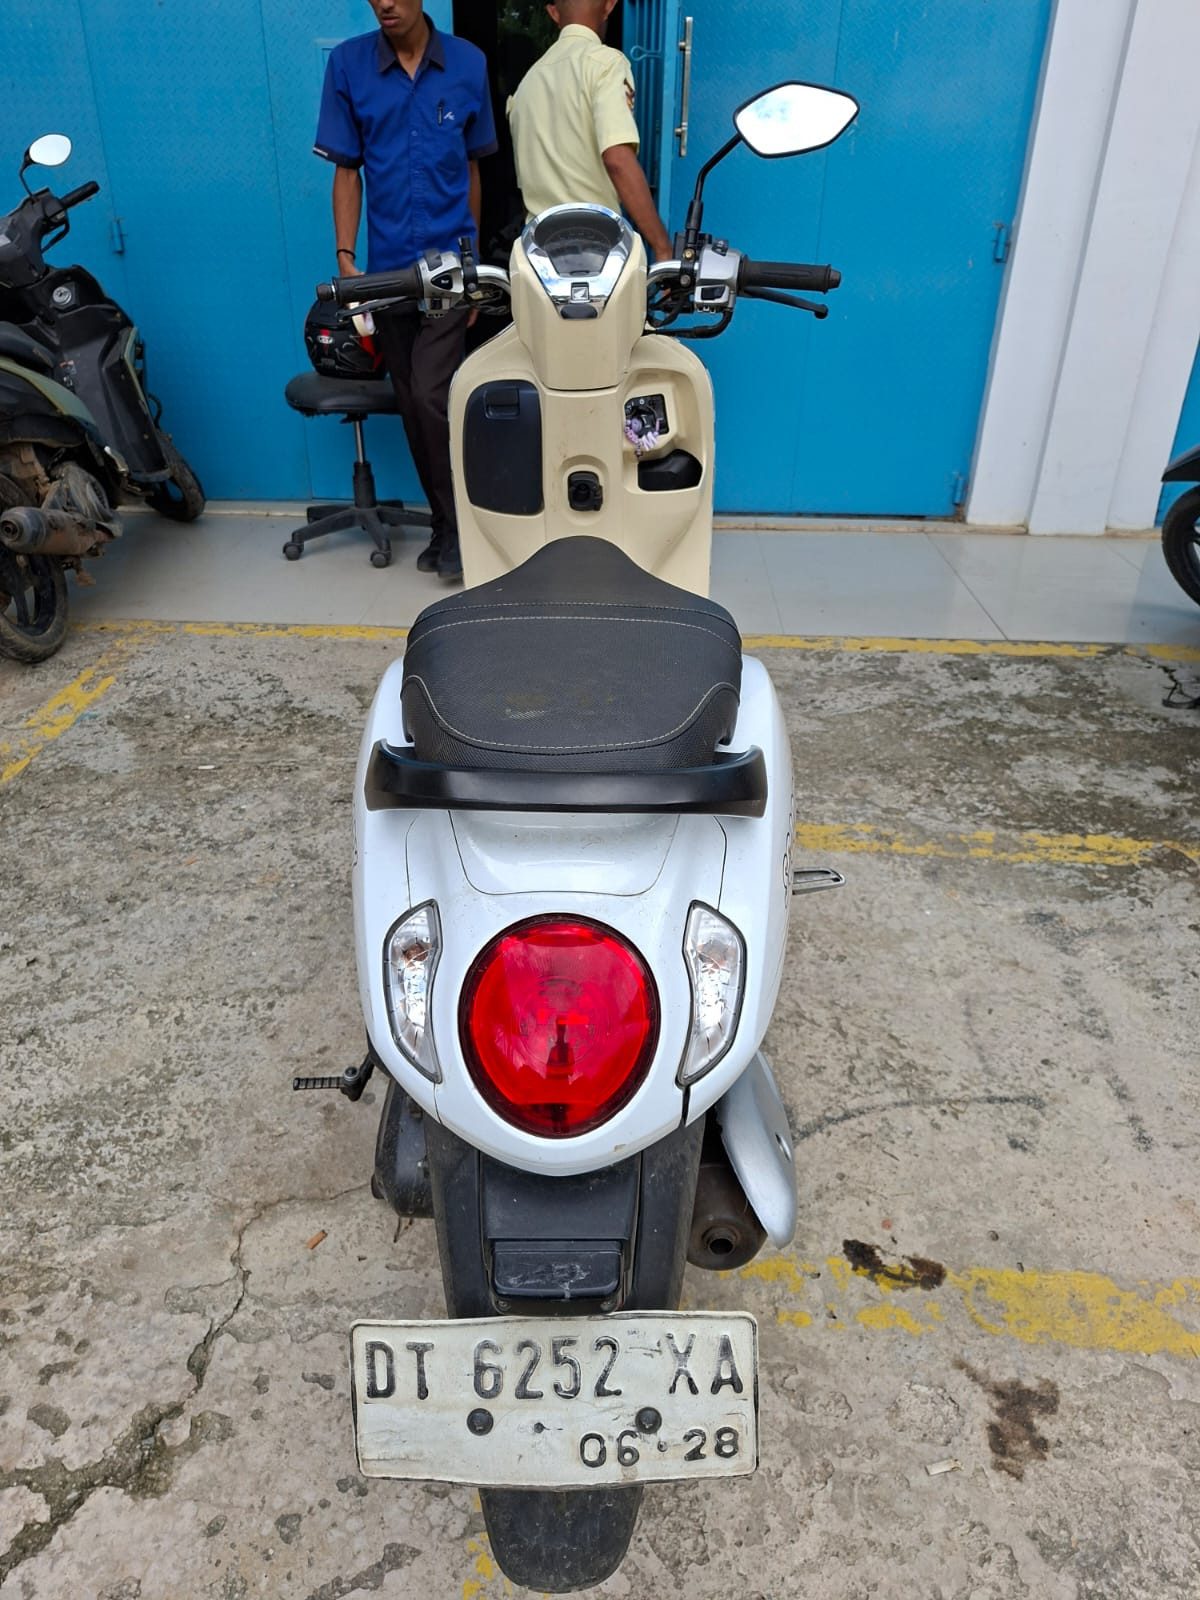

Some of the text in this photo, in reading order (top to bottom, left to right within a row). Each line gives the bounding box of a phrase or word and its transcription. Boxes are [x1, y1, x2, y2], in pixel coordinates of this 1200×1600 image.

[365, 1332, 743, 1400] DT 6252 XA
